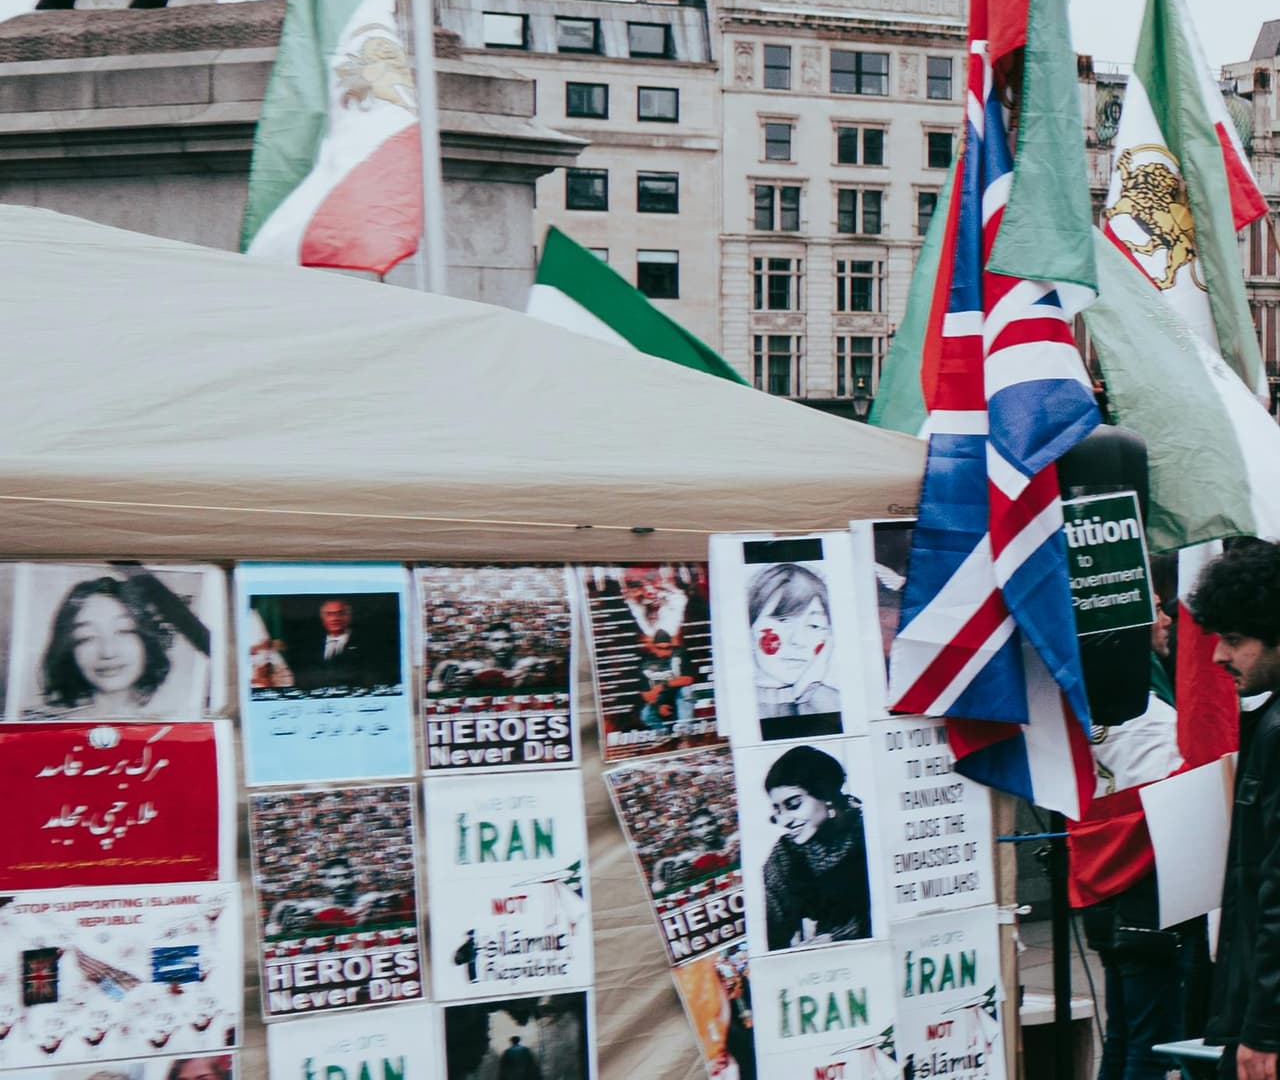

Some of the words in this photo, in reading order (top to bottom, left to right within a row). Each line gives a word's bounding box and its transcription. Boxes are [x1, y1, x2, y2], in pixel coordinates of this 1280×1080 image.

[1063, 516, 1140, 549] tition
[1077, 553, 1093, 568] to
[427, 715, 570, 745] HEROES
[908, 726, 932, 749] YOU
[126, 726, 173, 782] مرگ
[429, 745, 516, 767] Never
[523, 740, 571, 762] Die
[924, 755, 951, 778] HEL
[904, 817, 942, 842] CLOSE
[944, 812, 966, 836] THE
[894, 844, 962, 875] EMBASSIES
[963, 841, 978, 863] OF
[54, 898, 144, 913] SUPPORTING
[895, 881, 919, 905] THE
[76, 914, 145, 928] REPUBLIC
[662, 890, 745, 941] HERO
[670, 918, 746, 960] Never
[267, 950, 419, 990] HEROES
[269, 985, 361, 1012] Never
[368, 977, 421, 1001] Die
[926, 1019, 955, 1041] NOT
